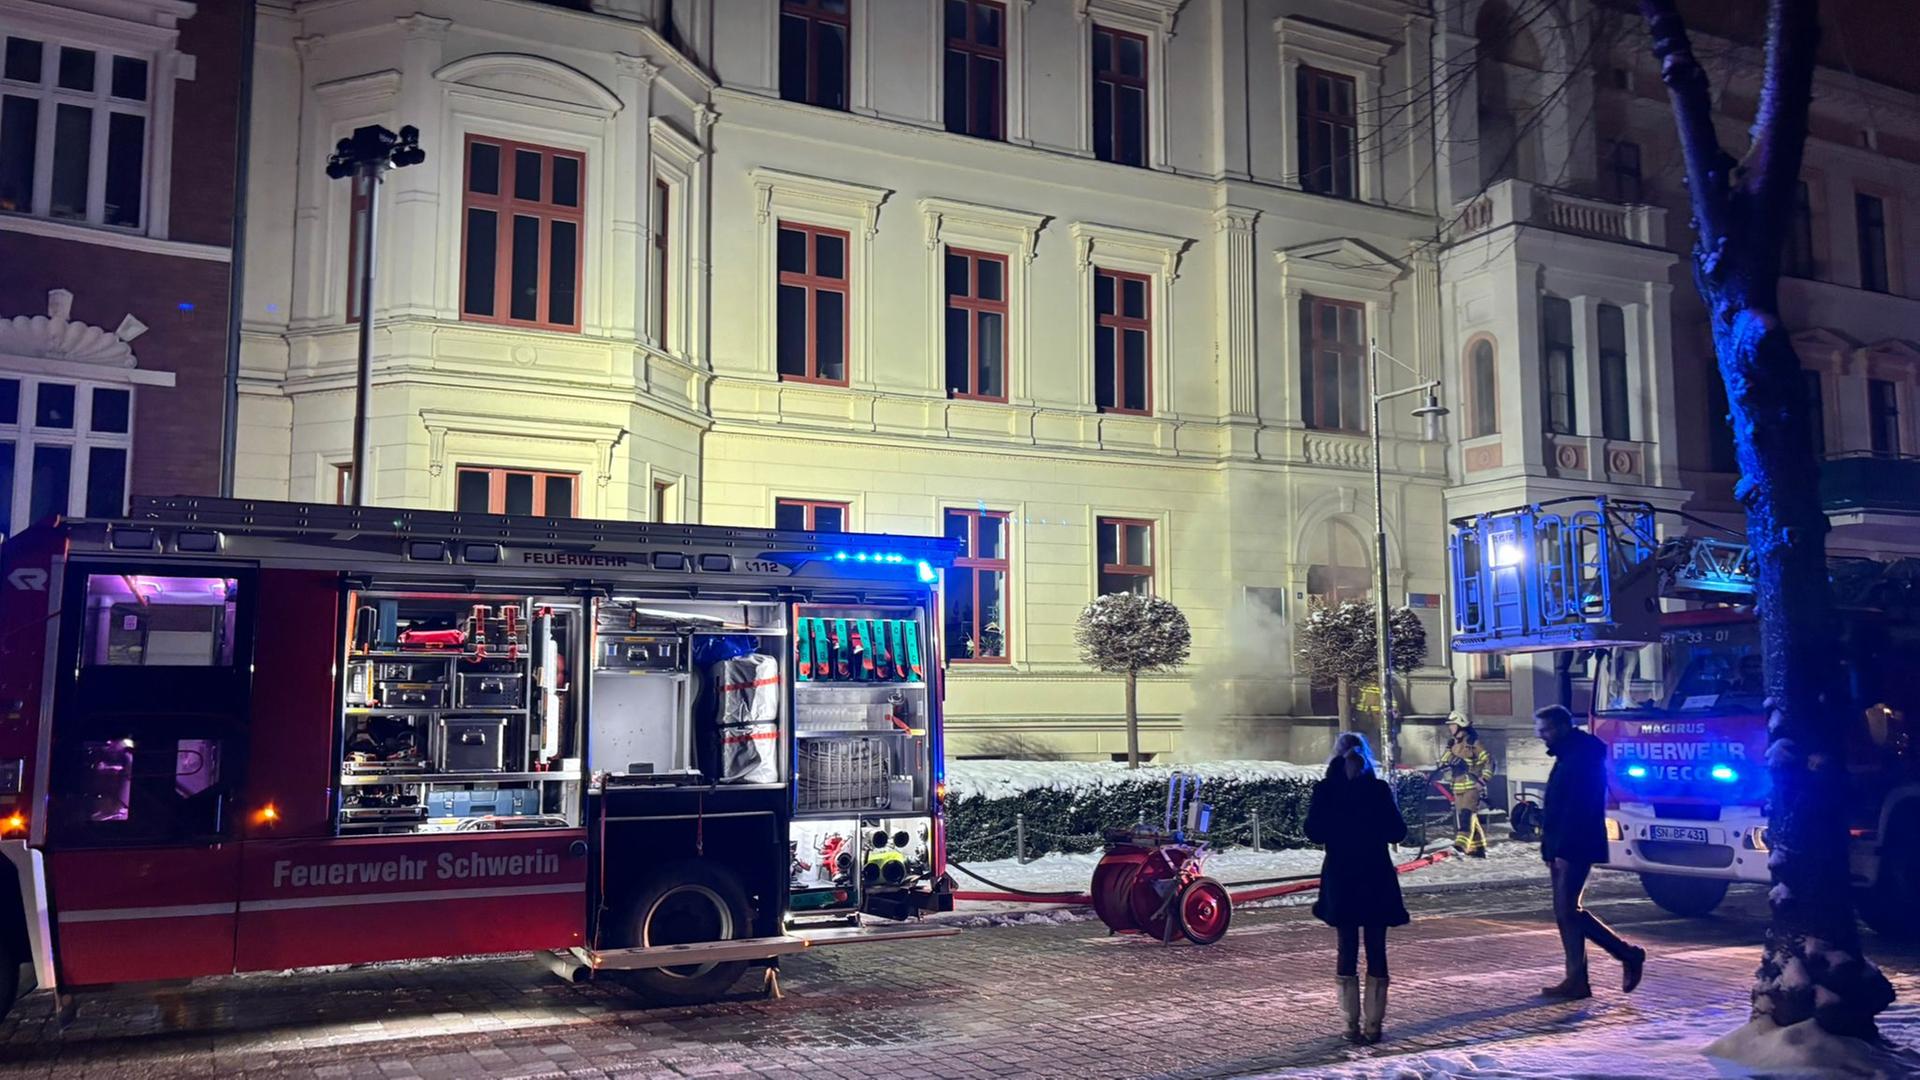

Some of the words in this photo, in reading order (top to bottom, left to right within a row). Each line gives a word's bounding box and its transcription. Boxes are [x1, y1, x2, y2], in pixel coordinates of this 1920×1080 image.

[523, 552, 627, 567] FEUERWEHR
[752, 562, 779, 573] 112
[1687, 632, 1703, 644] 33
[1715, 630, 1729, 642] 01
[1641, 723, 1705, 734] MAGIRUS
[1613, 742, 1746, 760] FEUERWEHR
[1687, 830, 1704, 841] 431
[273, 856, 428, 887] Feuerwehr
[437, 849, 559, 879] Schwerin
